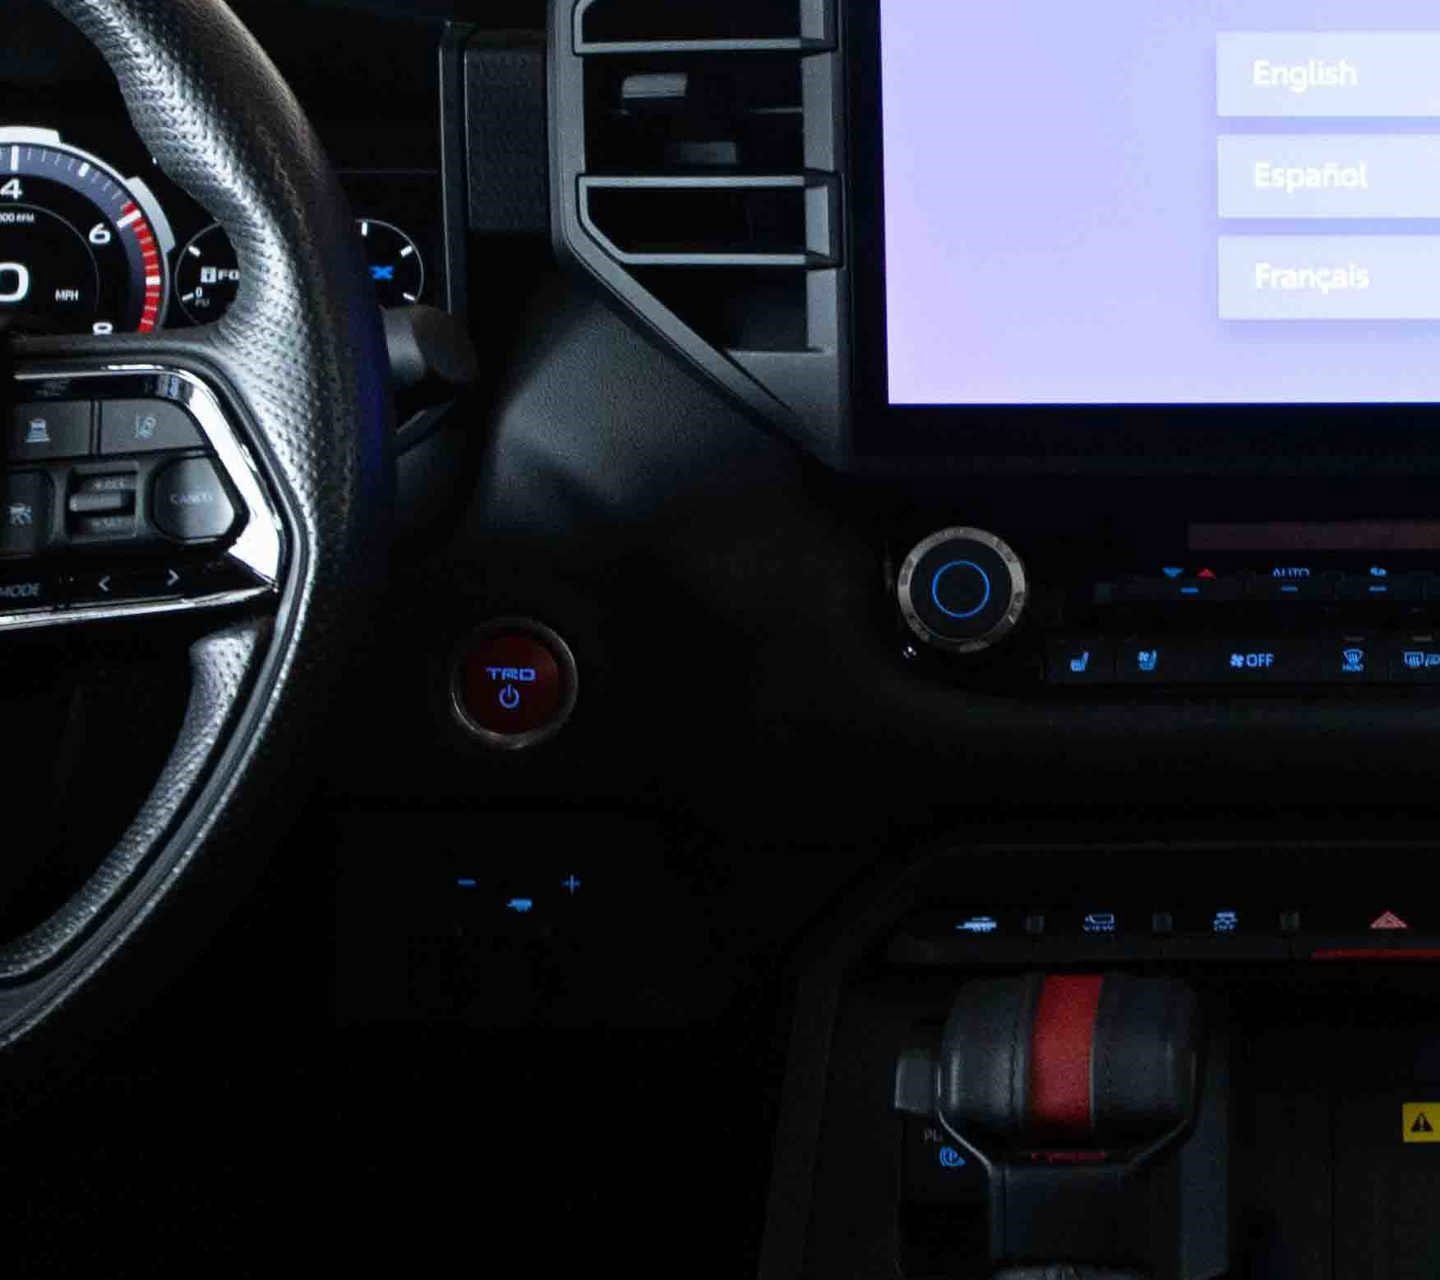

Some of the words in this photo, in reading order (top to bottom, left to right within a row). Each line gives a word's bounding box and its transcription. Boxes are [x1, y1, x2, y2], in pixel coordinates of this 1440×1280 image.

[1252, 58, 1358, 92] English
[1254, 160, 1368, 193] Español
[0, 177, 24, 201] 4
[88, 223, 112, 245] 6
[1255, 261, 1370, 294] Français
[55, 288, 80, 302] MPH
[1245, 652, 1276, 669] OFF
[485, 666, 537, 683] TRD
